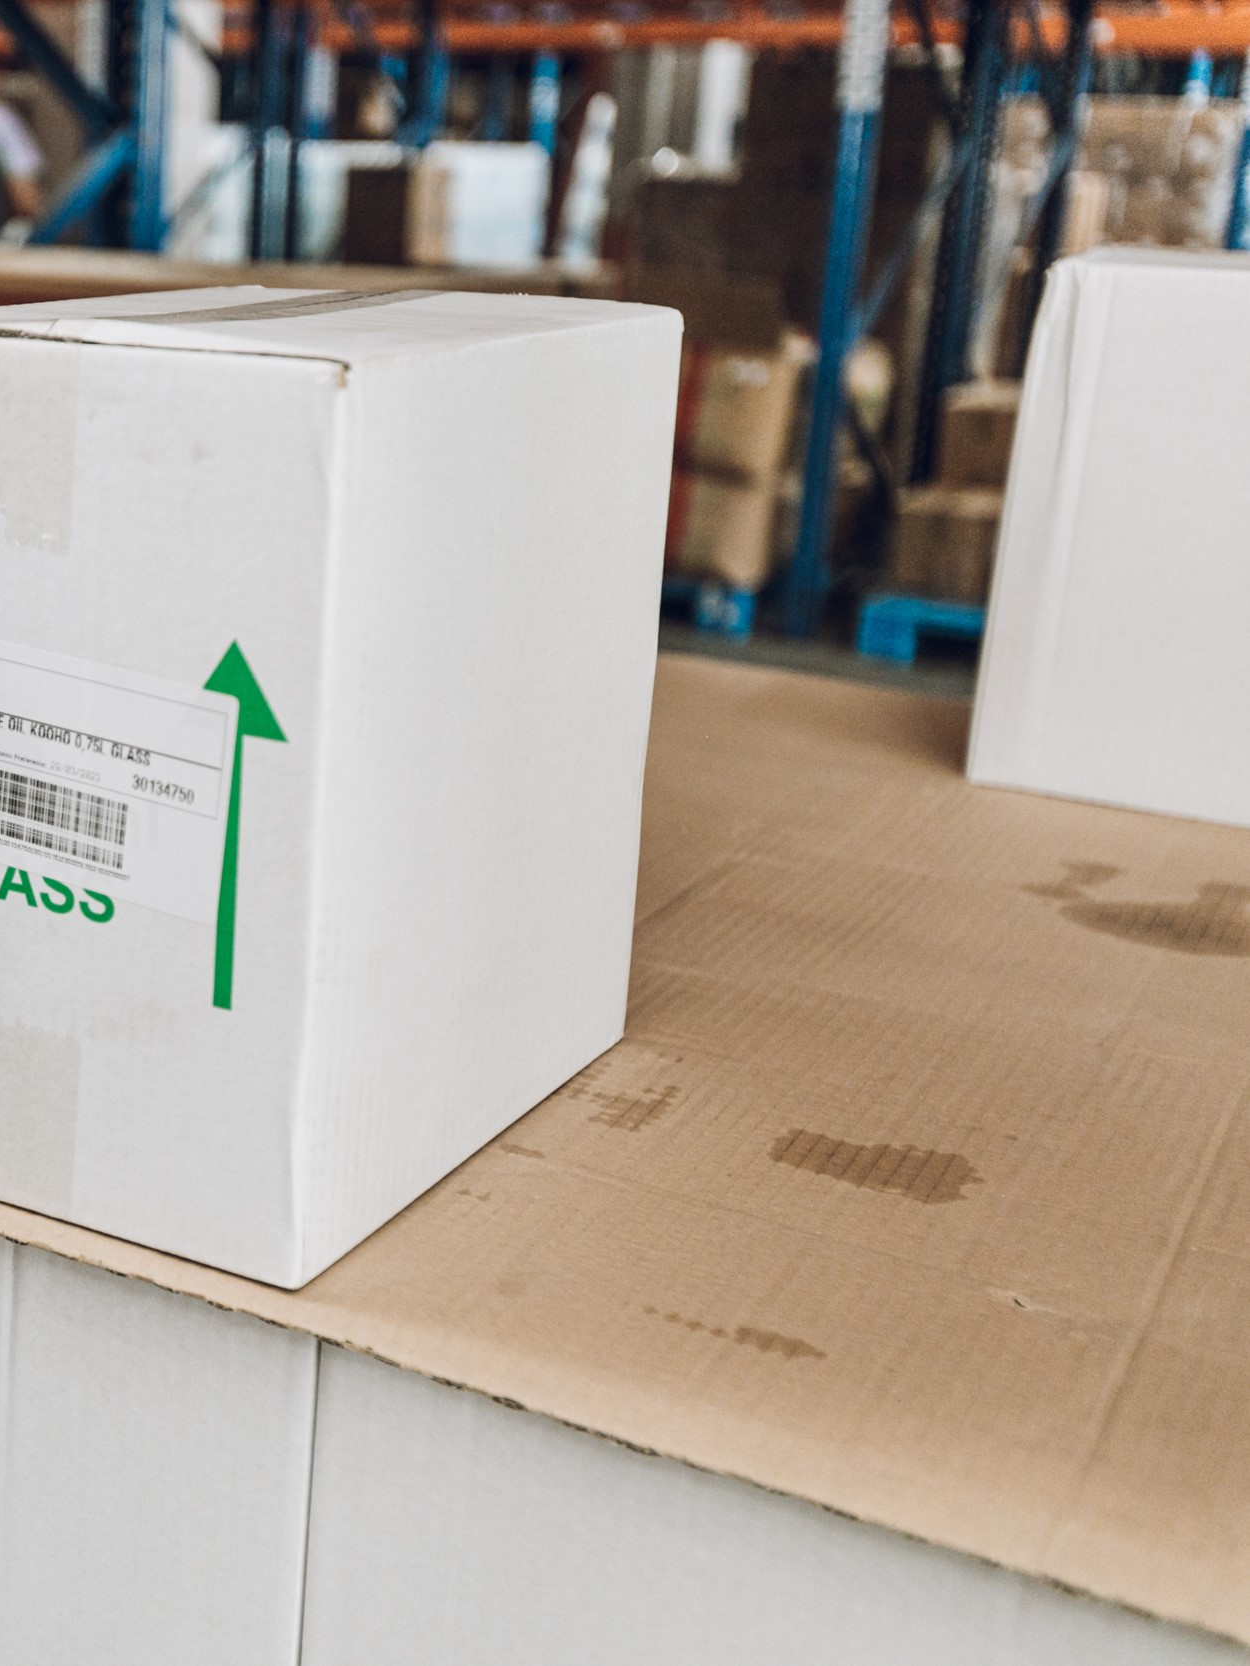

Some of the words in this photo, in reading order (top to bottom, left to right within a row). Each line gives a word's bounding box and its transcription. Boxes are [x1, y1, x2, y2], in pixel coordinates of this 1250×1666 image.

[8, 715, 25, 734] OIL
[75, 733, 105, 755] 0,75L
[111, 742, 151, 766] GLASS
[131, 773, 195, 805] 30134750
